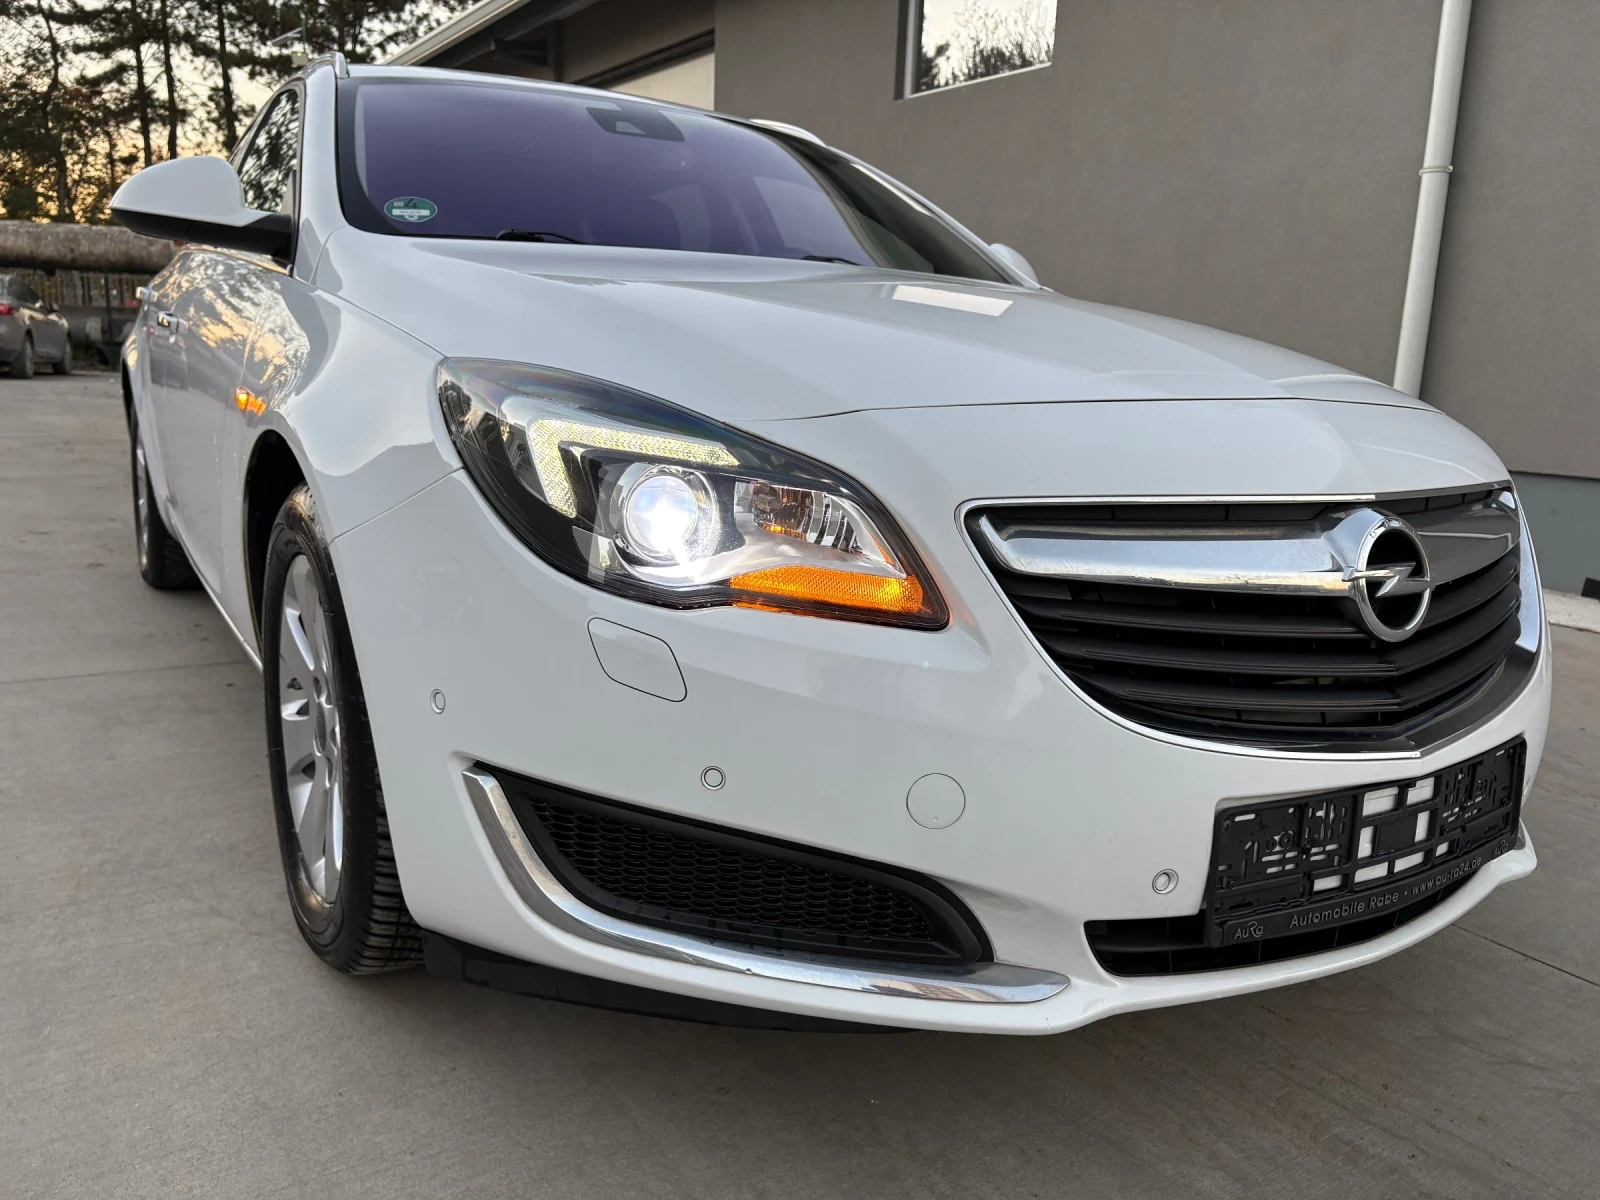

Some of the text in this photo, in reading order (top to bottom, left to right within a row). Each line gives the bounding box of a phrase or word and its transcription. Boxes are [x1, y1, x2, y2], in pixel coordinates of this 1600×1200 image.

[1289, 857, 1482, 928] Automobile Rabe www.au-ra24.de
